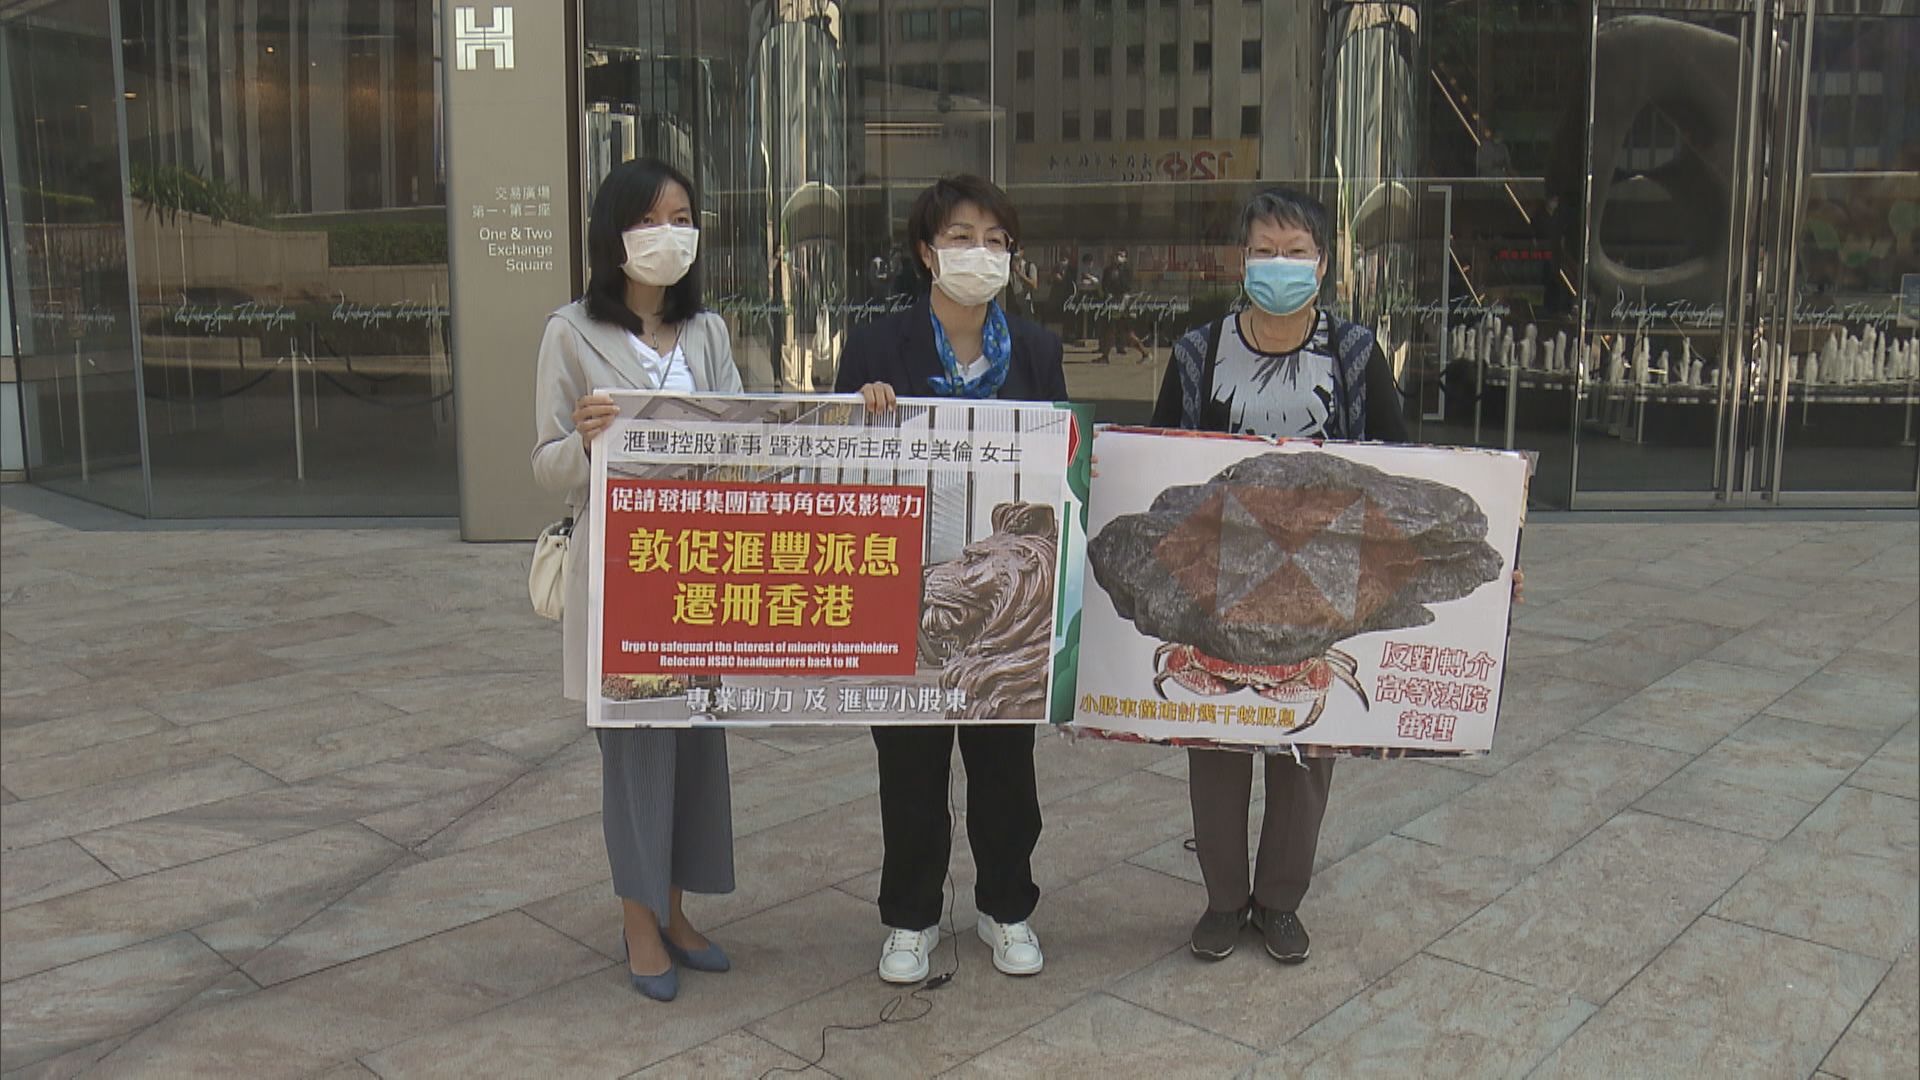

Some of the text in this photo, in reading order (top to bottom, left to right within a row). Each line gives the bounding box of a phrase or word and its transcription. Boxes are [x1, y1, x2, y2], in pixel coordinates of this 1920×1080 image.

[495, 184, 551, 201] 交易廣場
[479, 226, 552, 241] One & Two
[488, 242, 553, 258] Exchange
[506, 258, 553, 274] Square
[769, 434, 902, 460] 暨港交所主席
[908, 438, 973, 463] 史美倫
[980, 440, 1023, 463] 女士
[621, 639, 899, 655] Urge to safeguard the interest of minority shareholders
[660, 655, 860, 668] Relocate HSBC headquarters back to HK
[1380, 640, 1497, 681] 反對轉介
[685, 686, 793, 713] 專業動力
[803, 687, 829, 713] 及
[1375, 674, 1493, 714] 高等法院
[1397, 709, 1458, 743] 審理
